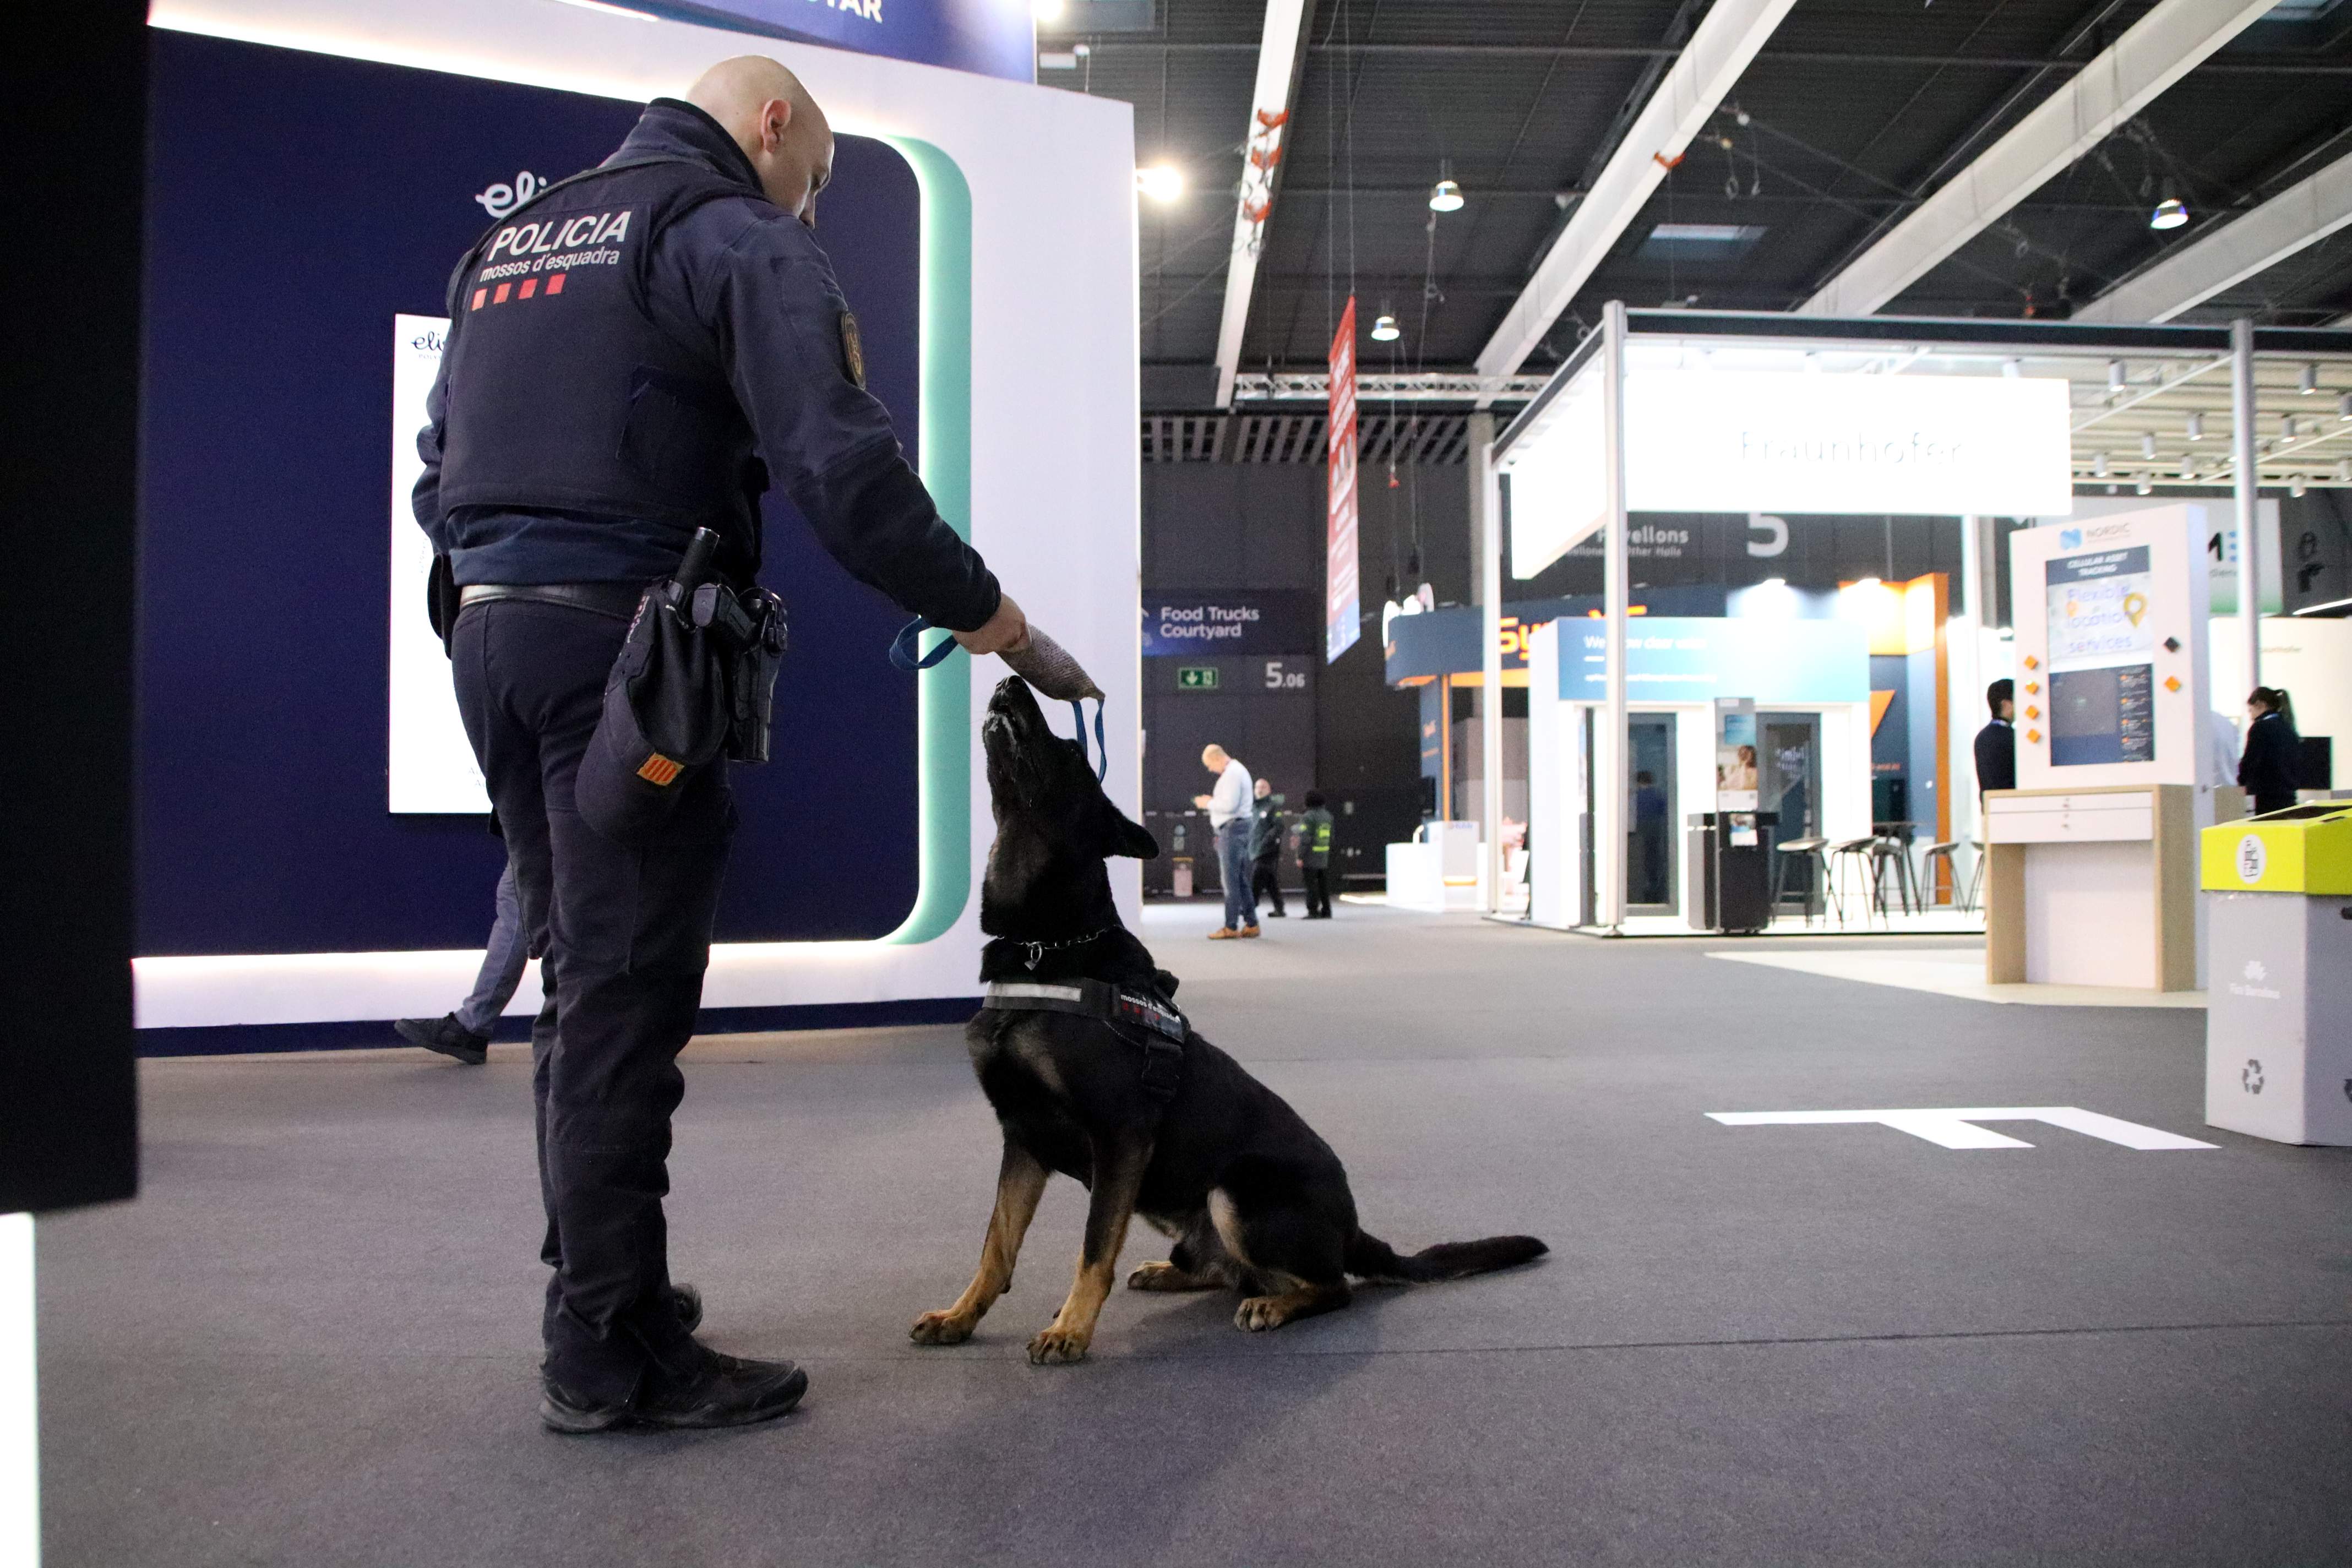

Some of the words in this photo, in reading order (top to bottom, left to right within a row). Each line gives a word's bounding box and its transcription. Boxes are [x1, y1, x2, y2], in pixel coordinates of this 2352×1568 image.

[487, 211, 631, 262] POLICIA
[480, 260, 531, 282] mossos
[532, 246, 620, 272] d'esquadra
[1747, 511, 1789, 557] 5
[1161, 607, 1203, 621] Food
[1207, 607, 1260, 621] Trucks
[1160, 623, 1242, 640] Courtyard
[1266, 662, 1305, 688] 5.06
[1120, 994, 1147, 1008] mossos
